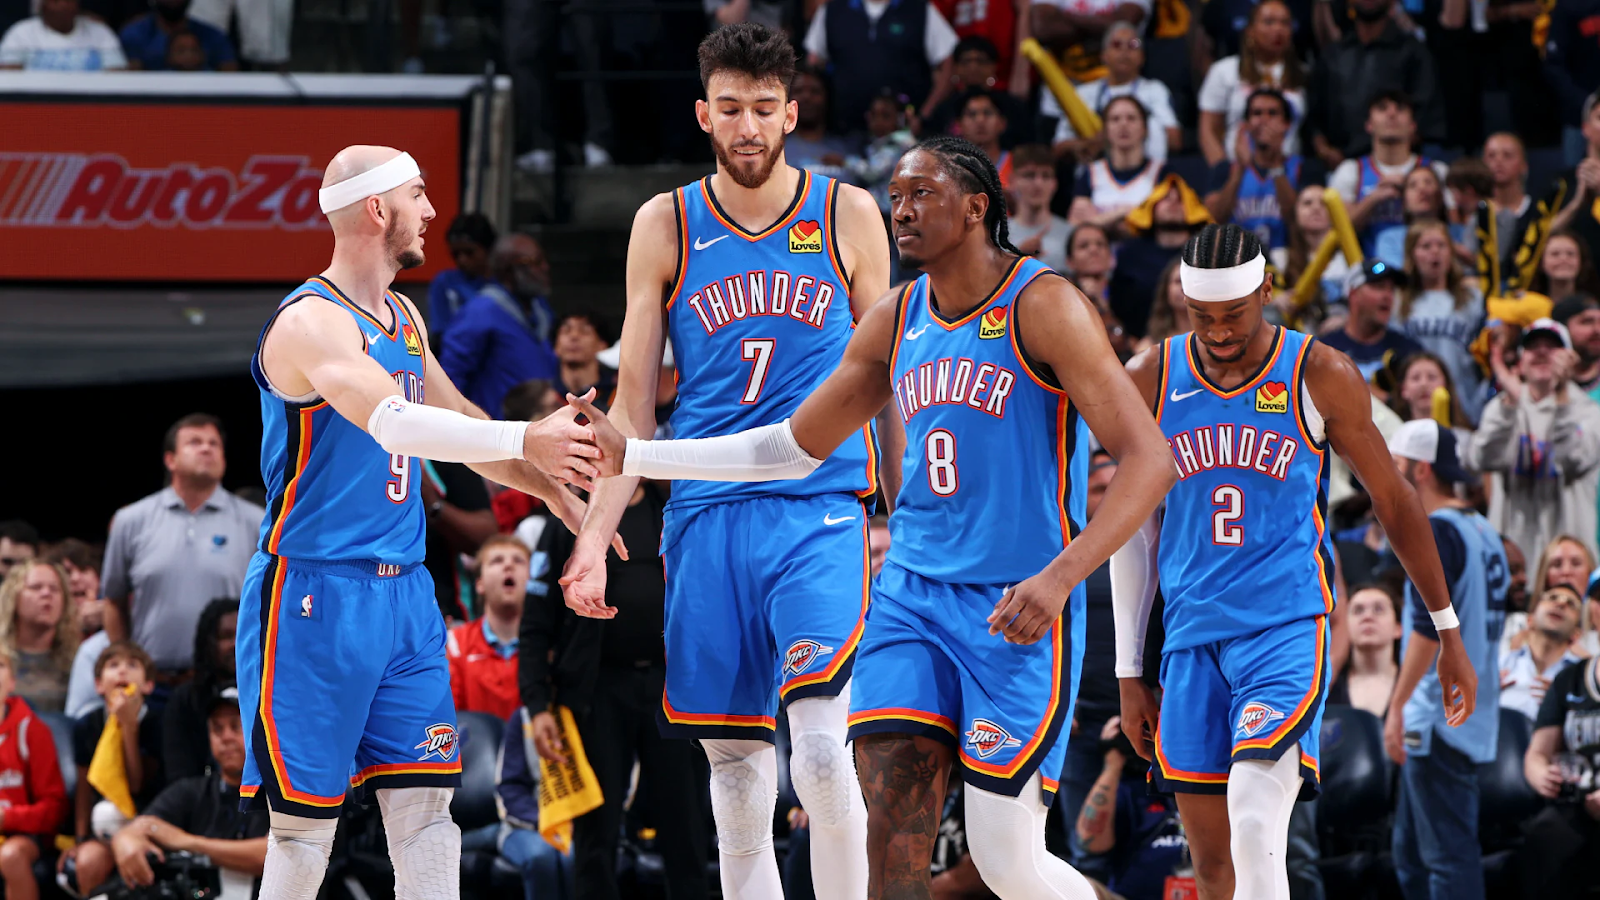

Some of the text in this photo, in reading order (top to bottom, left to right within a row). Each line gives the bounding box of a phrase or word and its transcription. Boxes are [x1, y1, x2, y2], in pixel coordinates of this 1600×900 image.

[53, 154, 334, 230] AutoZo
[689, 270, 835, 336] THUNDER
[740, 338, 776, 405] 7
[896, 357, 1017, 425] THUNDER
[386, 453, 410, 504] 9
[925, 427, 960, 497] 8
[1211, 483, 1245, 547] 2
[784, 646, 811, 672] OKC
[428, 732, 454, 752] OKC
[968, 729, 1000, 744] OKC
[1237, 710, 1265, 729] OKC
